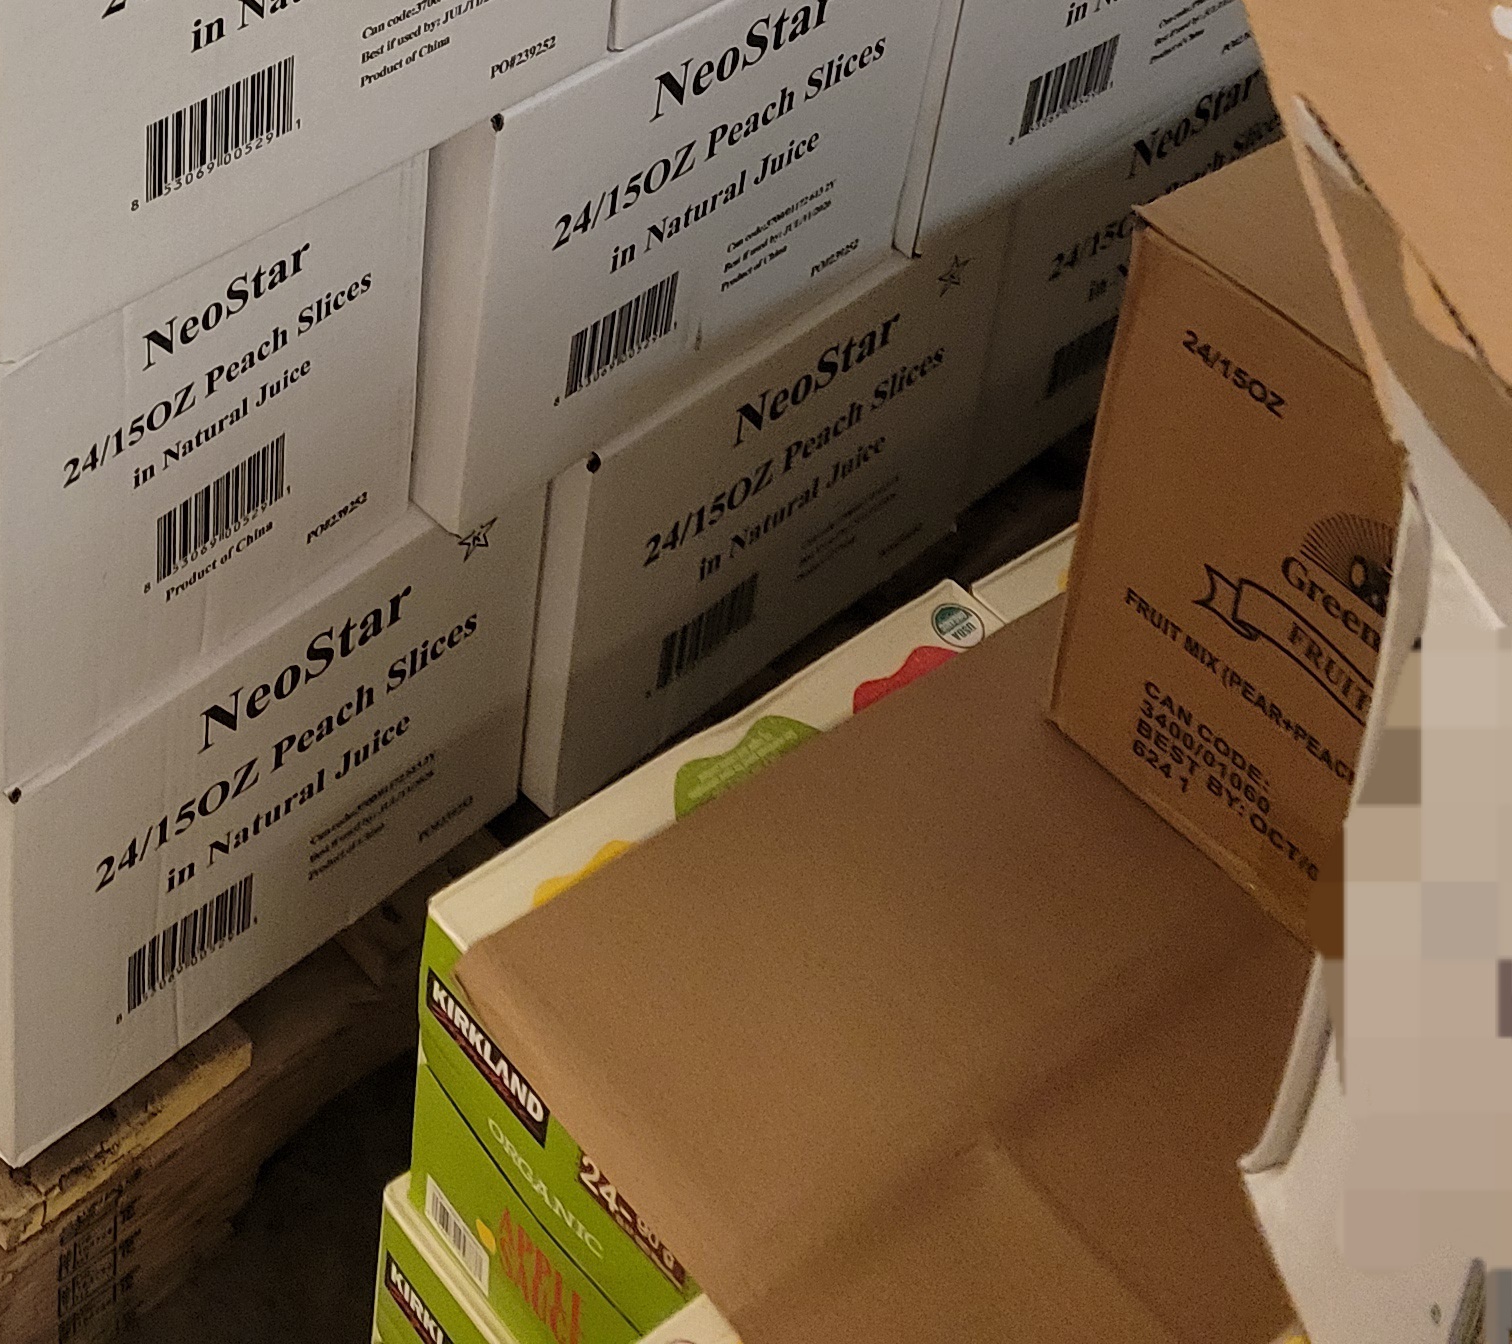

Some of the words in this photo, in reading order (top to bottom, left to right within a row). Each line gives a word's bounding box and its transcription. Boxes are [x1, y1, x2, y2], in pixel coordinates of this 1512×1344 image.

[191, 18, 225, 53] in
[198, 586, 411, 754] NeoStar
[951, 622, 977, 641] USDA
[1125, 587, 1182, 642] FRUIT
[1184, 635, 1220, 677] MIX
[1288, 621, 1372, 712] FRUIT
[95, 757, 259, 892] 24/15OZ
[271, 685, 374, 773] Peach
[386, 613, 477, 694] Slices
[1132, 739, 1173, 779] 624
[1136, 717, 1201, 776] BEST
[1206, 775, 1245, 816] BY:
[1144, 680, 1193, 727] CAN
[1197, 723, 1271, 792] CODE:
[431, 980, 545, 1123] KIRKLAND
[488, 1117, 604, 1259] ORGANIC
